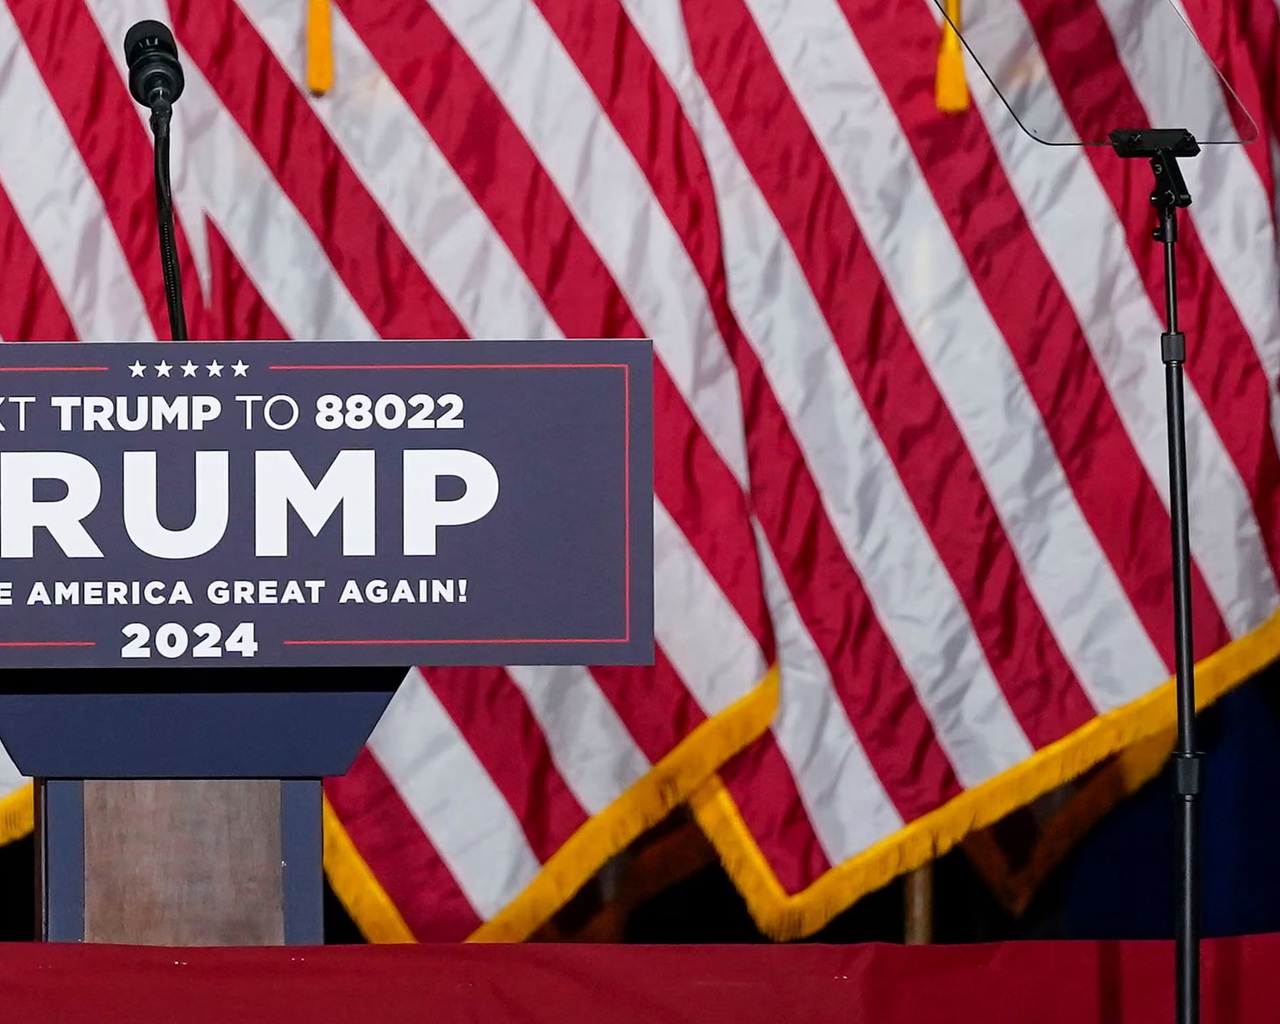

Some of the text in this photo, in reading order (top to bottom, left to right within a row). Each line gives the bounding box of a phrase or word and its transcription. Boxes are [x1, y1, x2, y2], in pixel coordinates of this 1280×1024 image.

[50, 395, 221, 431] TRUMP
[235, 394, 299, 430] TO
[315, 393, 464, 430] 88022
[26, 580, 193, 605] AMERICA
[207, 580, 325, 604] GREAT
[338, 579, 467, 603] AGAIN!
[121, 622, 259, 658] 2024
